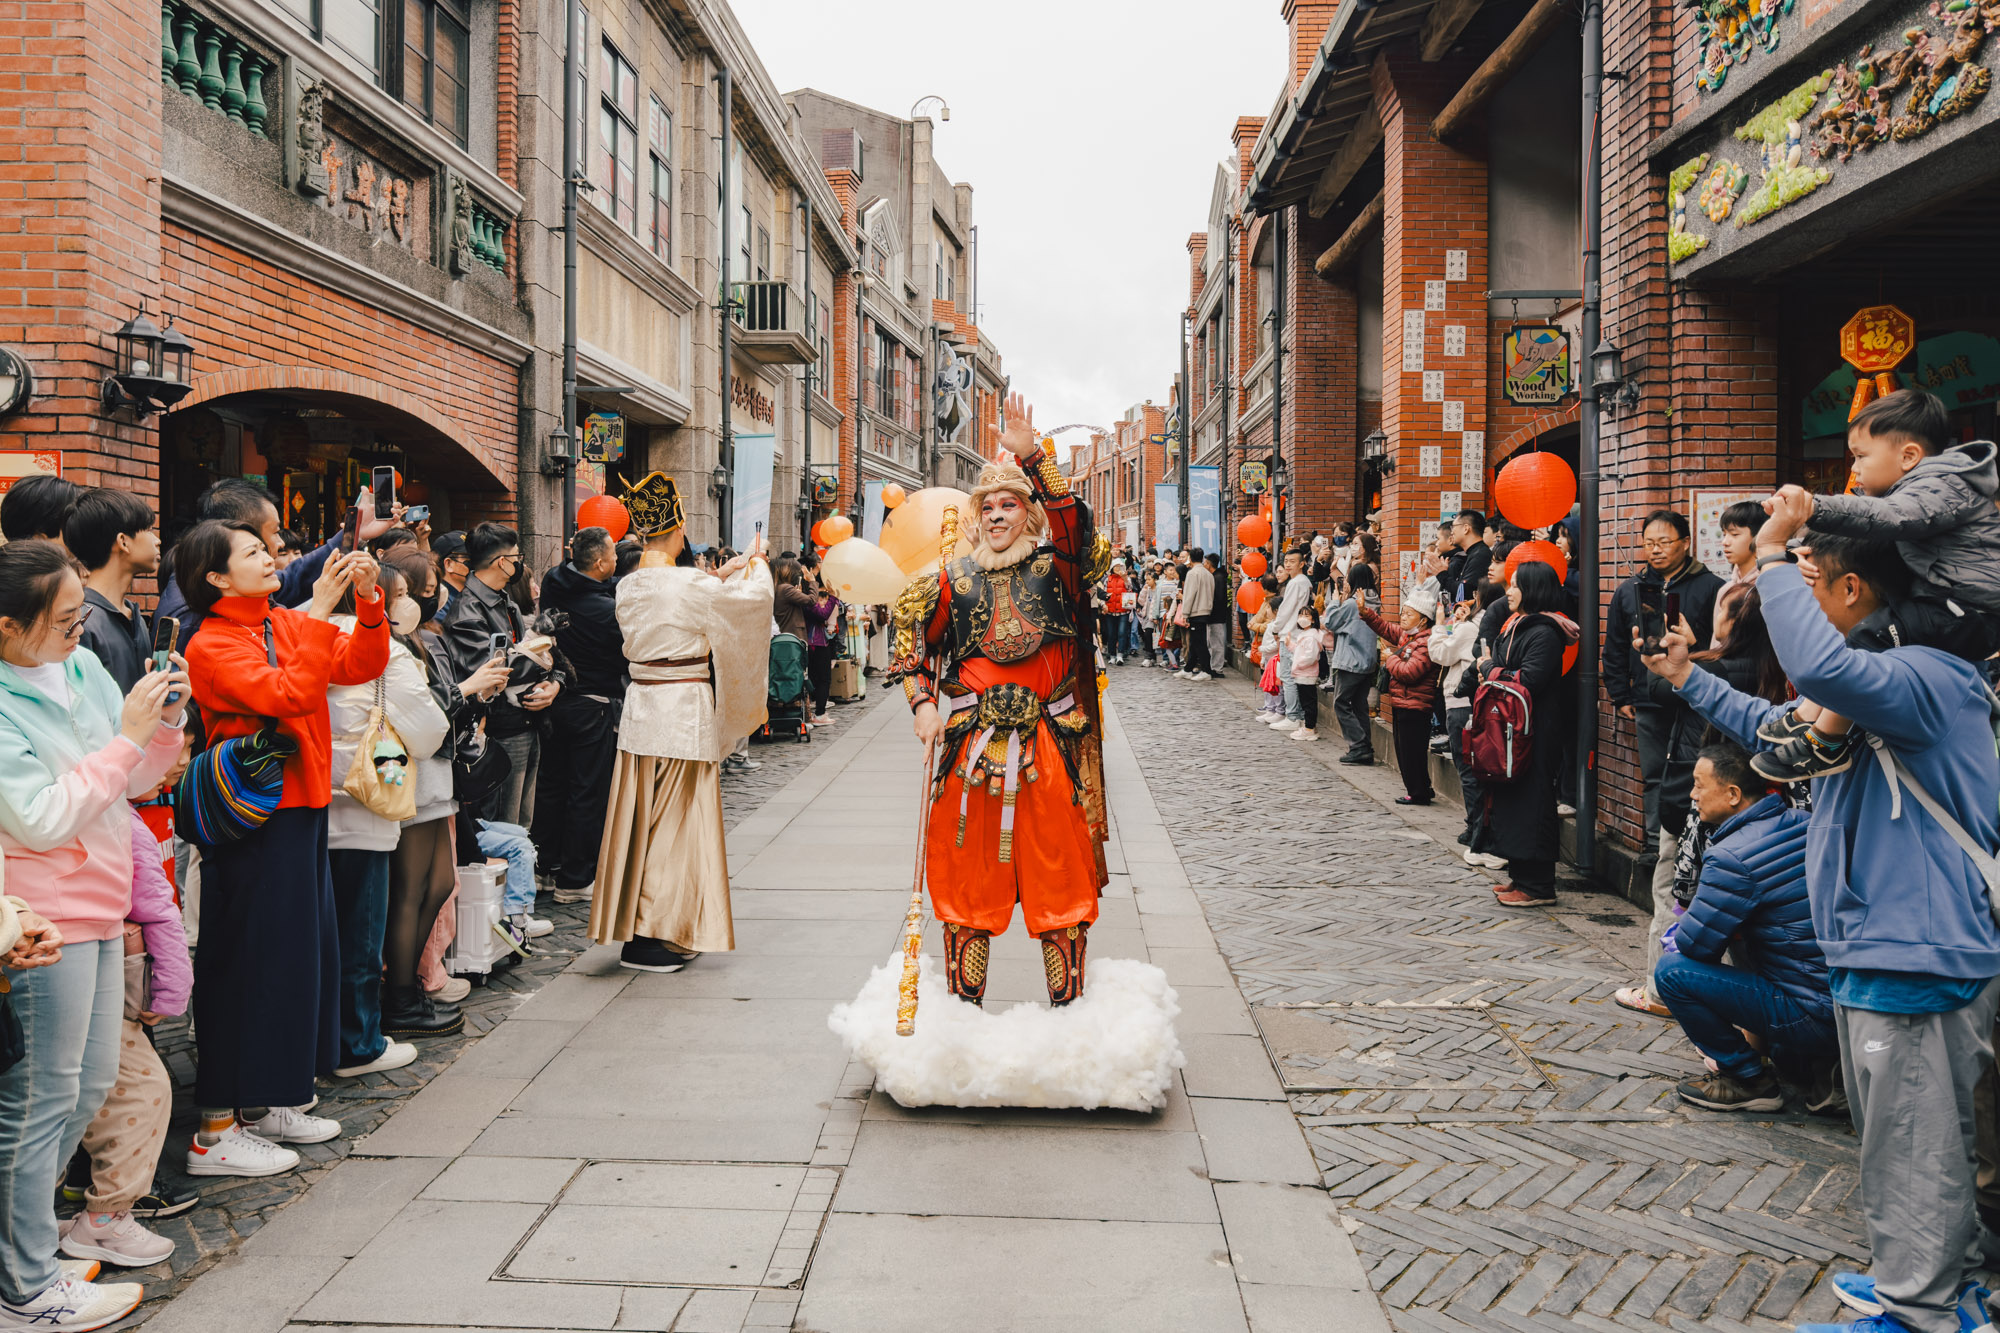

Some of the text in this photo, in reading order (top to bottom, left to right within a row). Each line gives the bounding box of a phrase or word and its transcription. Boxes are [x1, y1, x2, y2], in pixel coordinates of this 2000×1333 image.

[1860, 320, 1894, 351] 福
[1542, 364, 1564, 386] 木
[1508, 380, 1546, 391] Wood
[1516, 392, 1556, 400] Working
